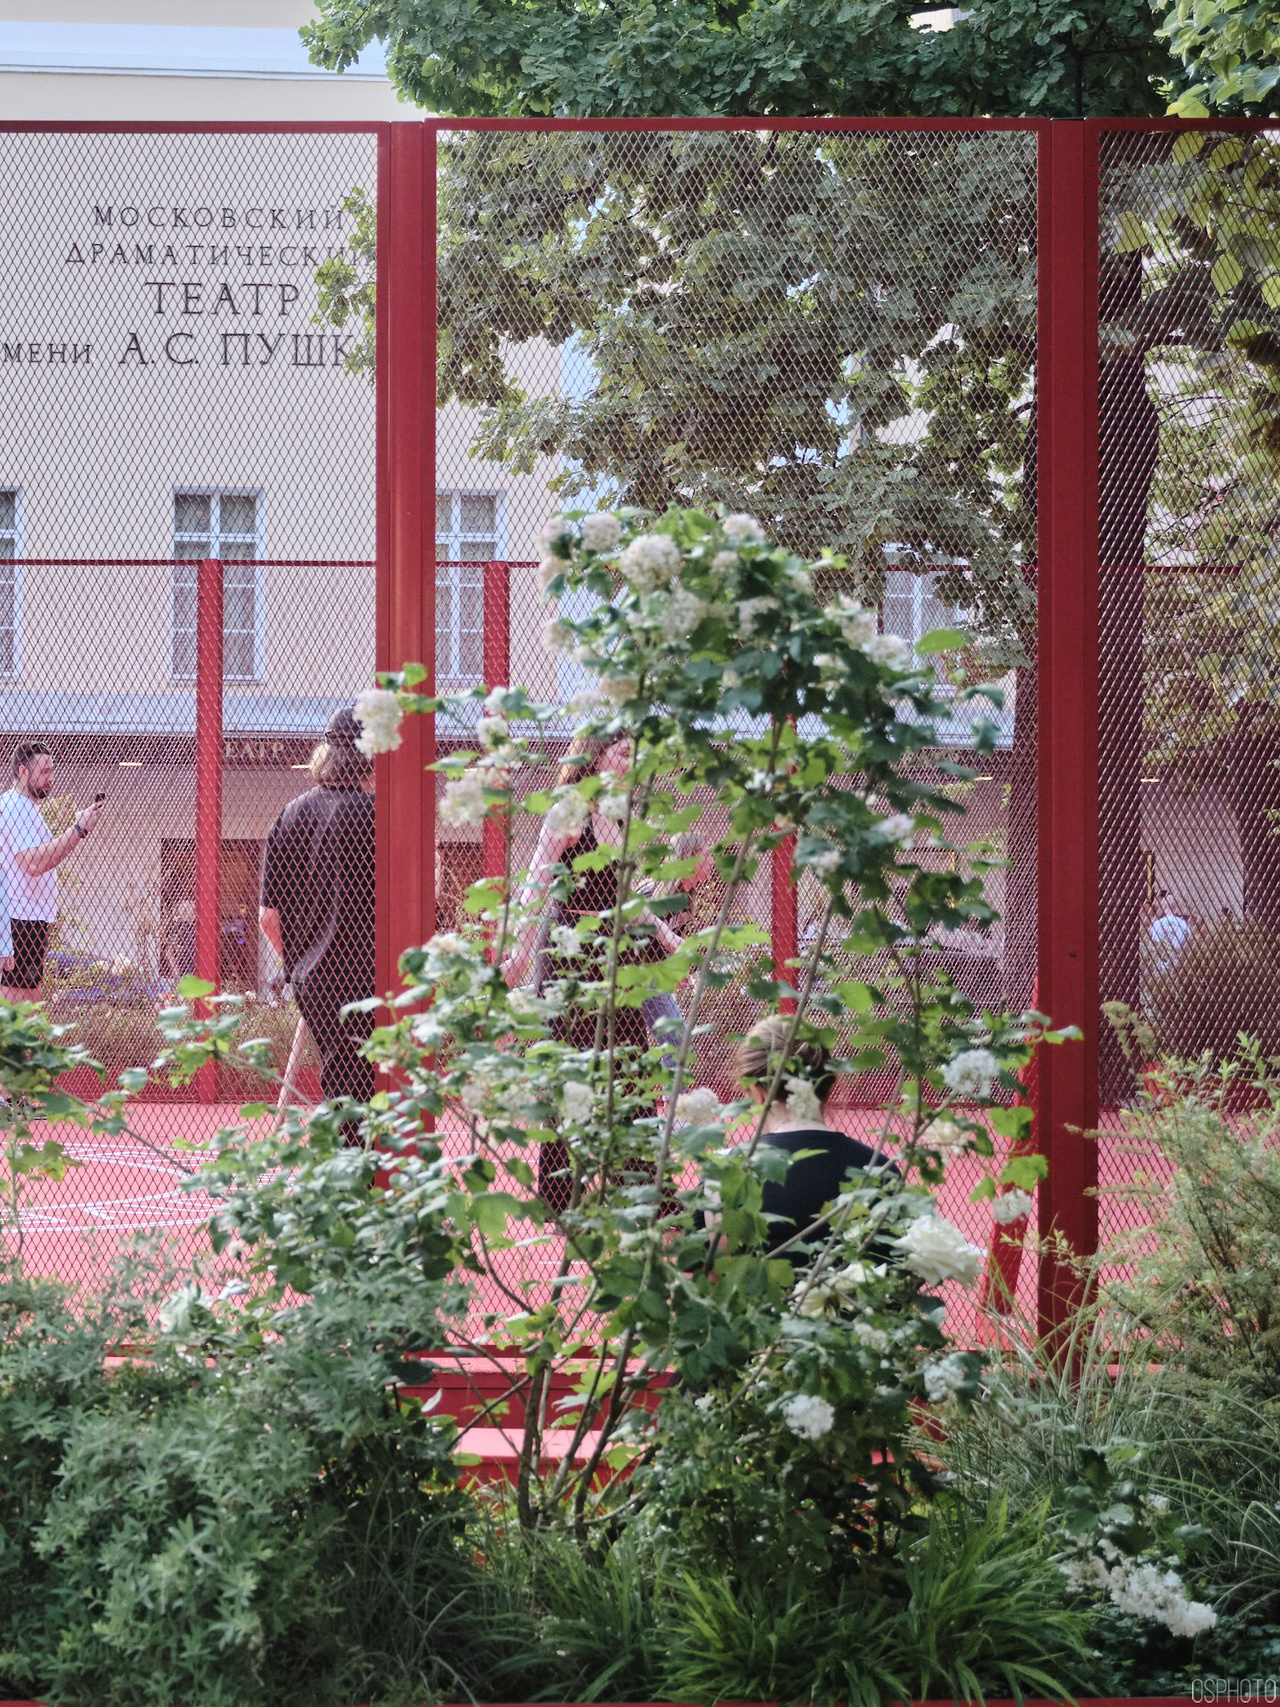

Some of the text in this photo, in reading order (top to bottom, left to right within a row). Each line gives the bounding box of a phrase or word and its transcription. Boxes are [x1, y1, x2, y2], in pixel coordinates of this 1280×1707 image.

[93, 204, 343, 230] МОСКОВСКИЙ
[145, 282, 300, 315] ТЕАТР
[221, 333, 354, 366] ПУШК
[222, 741, 284, 759] ЕАТР
